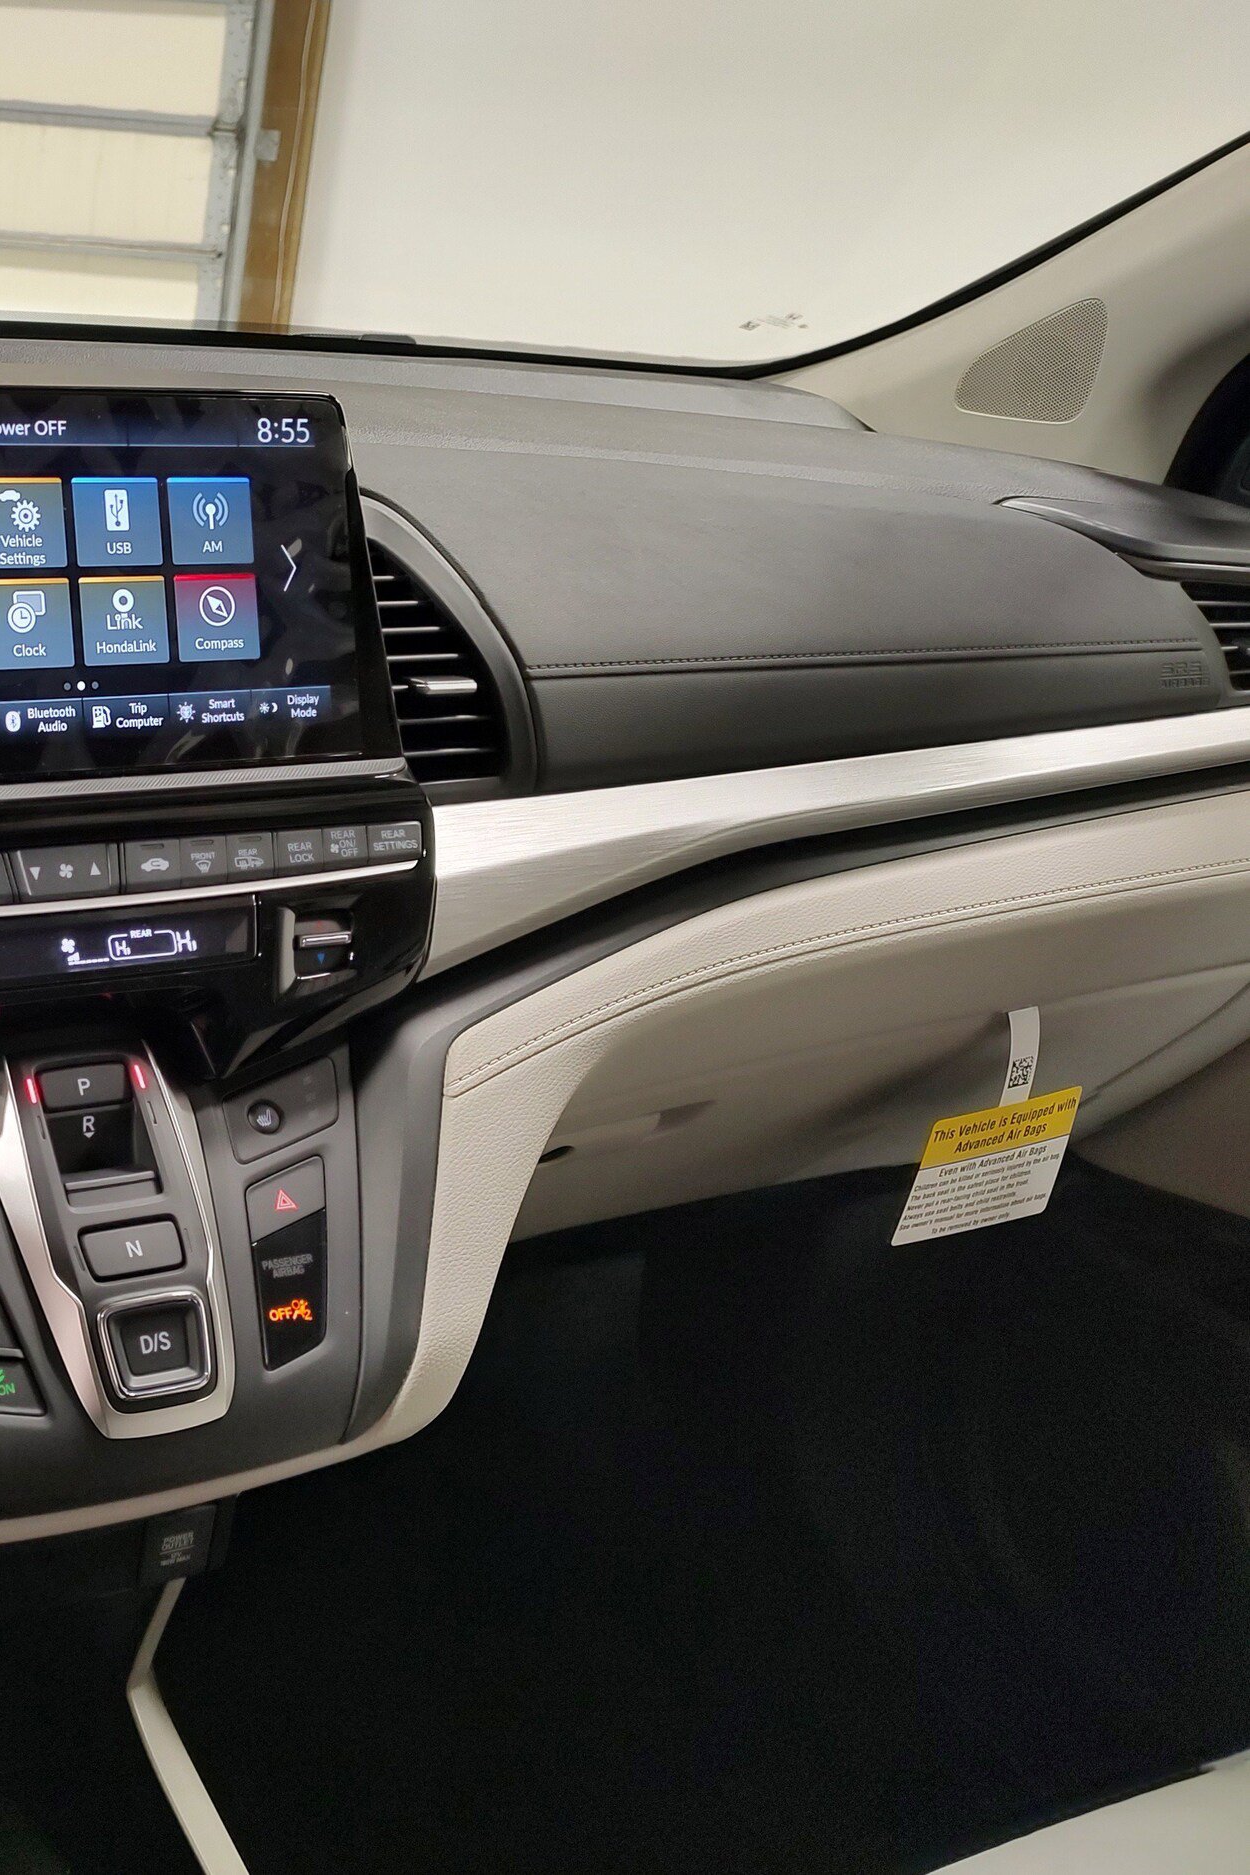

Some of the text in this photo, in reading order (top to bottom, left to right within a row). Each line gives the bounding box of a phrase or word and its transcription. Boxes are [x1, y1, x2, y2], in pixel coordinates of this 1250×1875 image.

[34, 420, 67, 436] OFF
[256, 417, 311, 444] 8:55
[0, 534, 43, 549] Vehicle
[106, 542, 132, 555] USB
[202, 540, 224, 554] AM
[0, 552, 46, 568] Settings
[106, 613, 144, 632] Link
[12, 644, 47, 658] Clock
[96, 639, 157, 655] HondaLink
[195, 638, 245, 653] Compass
[208, 698, 236, 711] Smart
[286, 694, 320, 708] Display
[27, 704, 77, 719] Bluetooth
[128, 702, 148, 717] Trip
[201, 710, 245, 724] Shortcuts
[291, 707, 318, 719] Mode
[37, 720, 68, 734] Audio
[115, 715, 164, 730] Computer
[330, 829, 356, 840] REAR
[381, 829, 407, 839] REAR
[237, 848, 258, 857] REAR
[287, 841, 313, 852] REAR
[340, 848, 359, 858] OFF
[373, 839, 419, 852] SETTINGS
[191, 851, 216, 861] FRONT
[289, 852, 315, 864] LOCK
[130, 928, 153, 939] REAR
[77, 1078, 91, 1097] P
[82, 1115, 96, 1132] R
[933, 1127, 956, 1143] This
[959, 1118, 997, 1137] Vehicle
[1010, 1102, 1056, 1126] Equipped
[1057, 1096, 1077, 1113] with
[953, 1123, 1048, 1154] Advanced Air Bags
[938, 1145, 1048, 1178] Even with Advanced Air Bags
[125, 1238, 144, 1259] N
[261, 1253, 314, 1271] PASSENGER
[272, 1265, 306, 1279] AIRBAG
[269, 1306, 293, 1321] OFF
[139, 1331, 172, 1355] D/S
